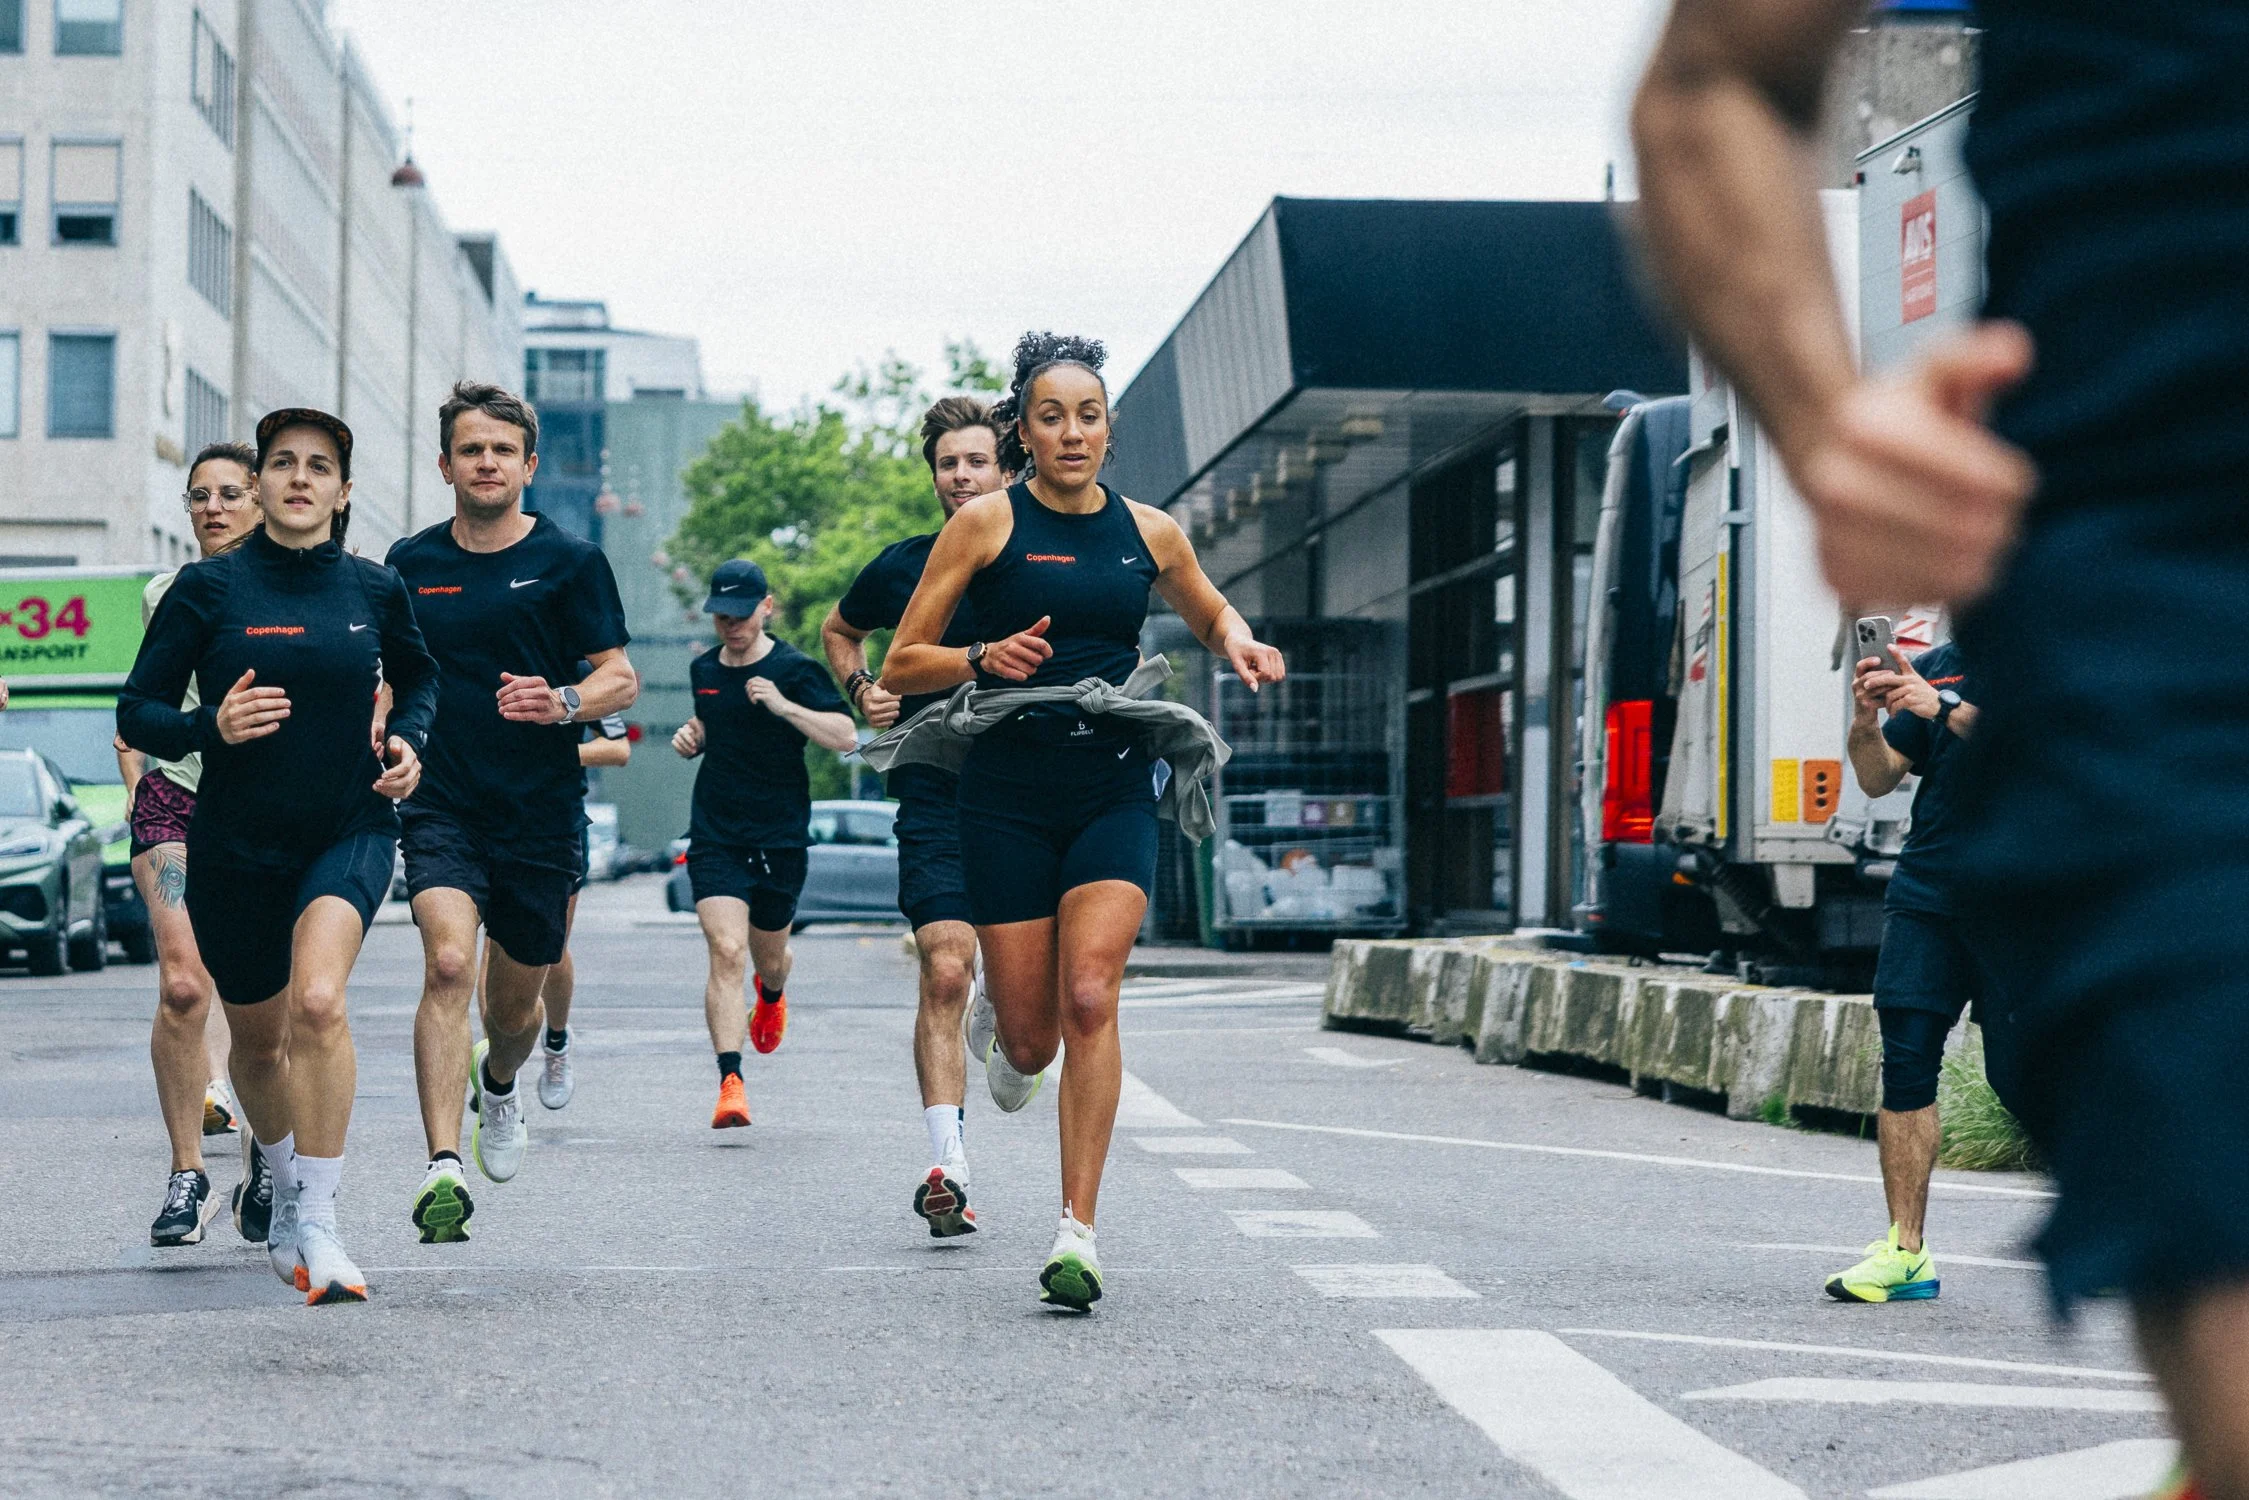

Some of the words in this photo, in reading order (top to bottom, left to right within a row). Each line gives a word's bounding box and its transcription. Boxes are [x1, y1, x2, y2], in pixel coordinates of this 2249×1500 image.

[1026, 553, 1076, 563] Copenhagen
[418, 586, 462, 595] Copenhagen
[246, 626, 305, 635] Copenhagen
